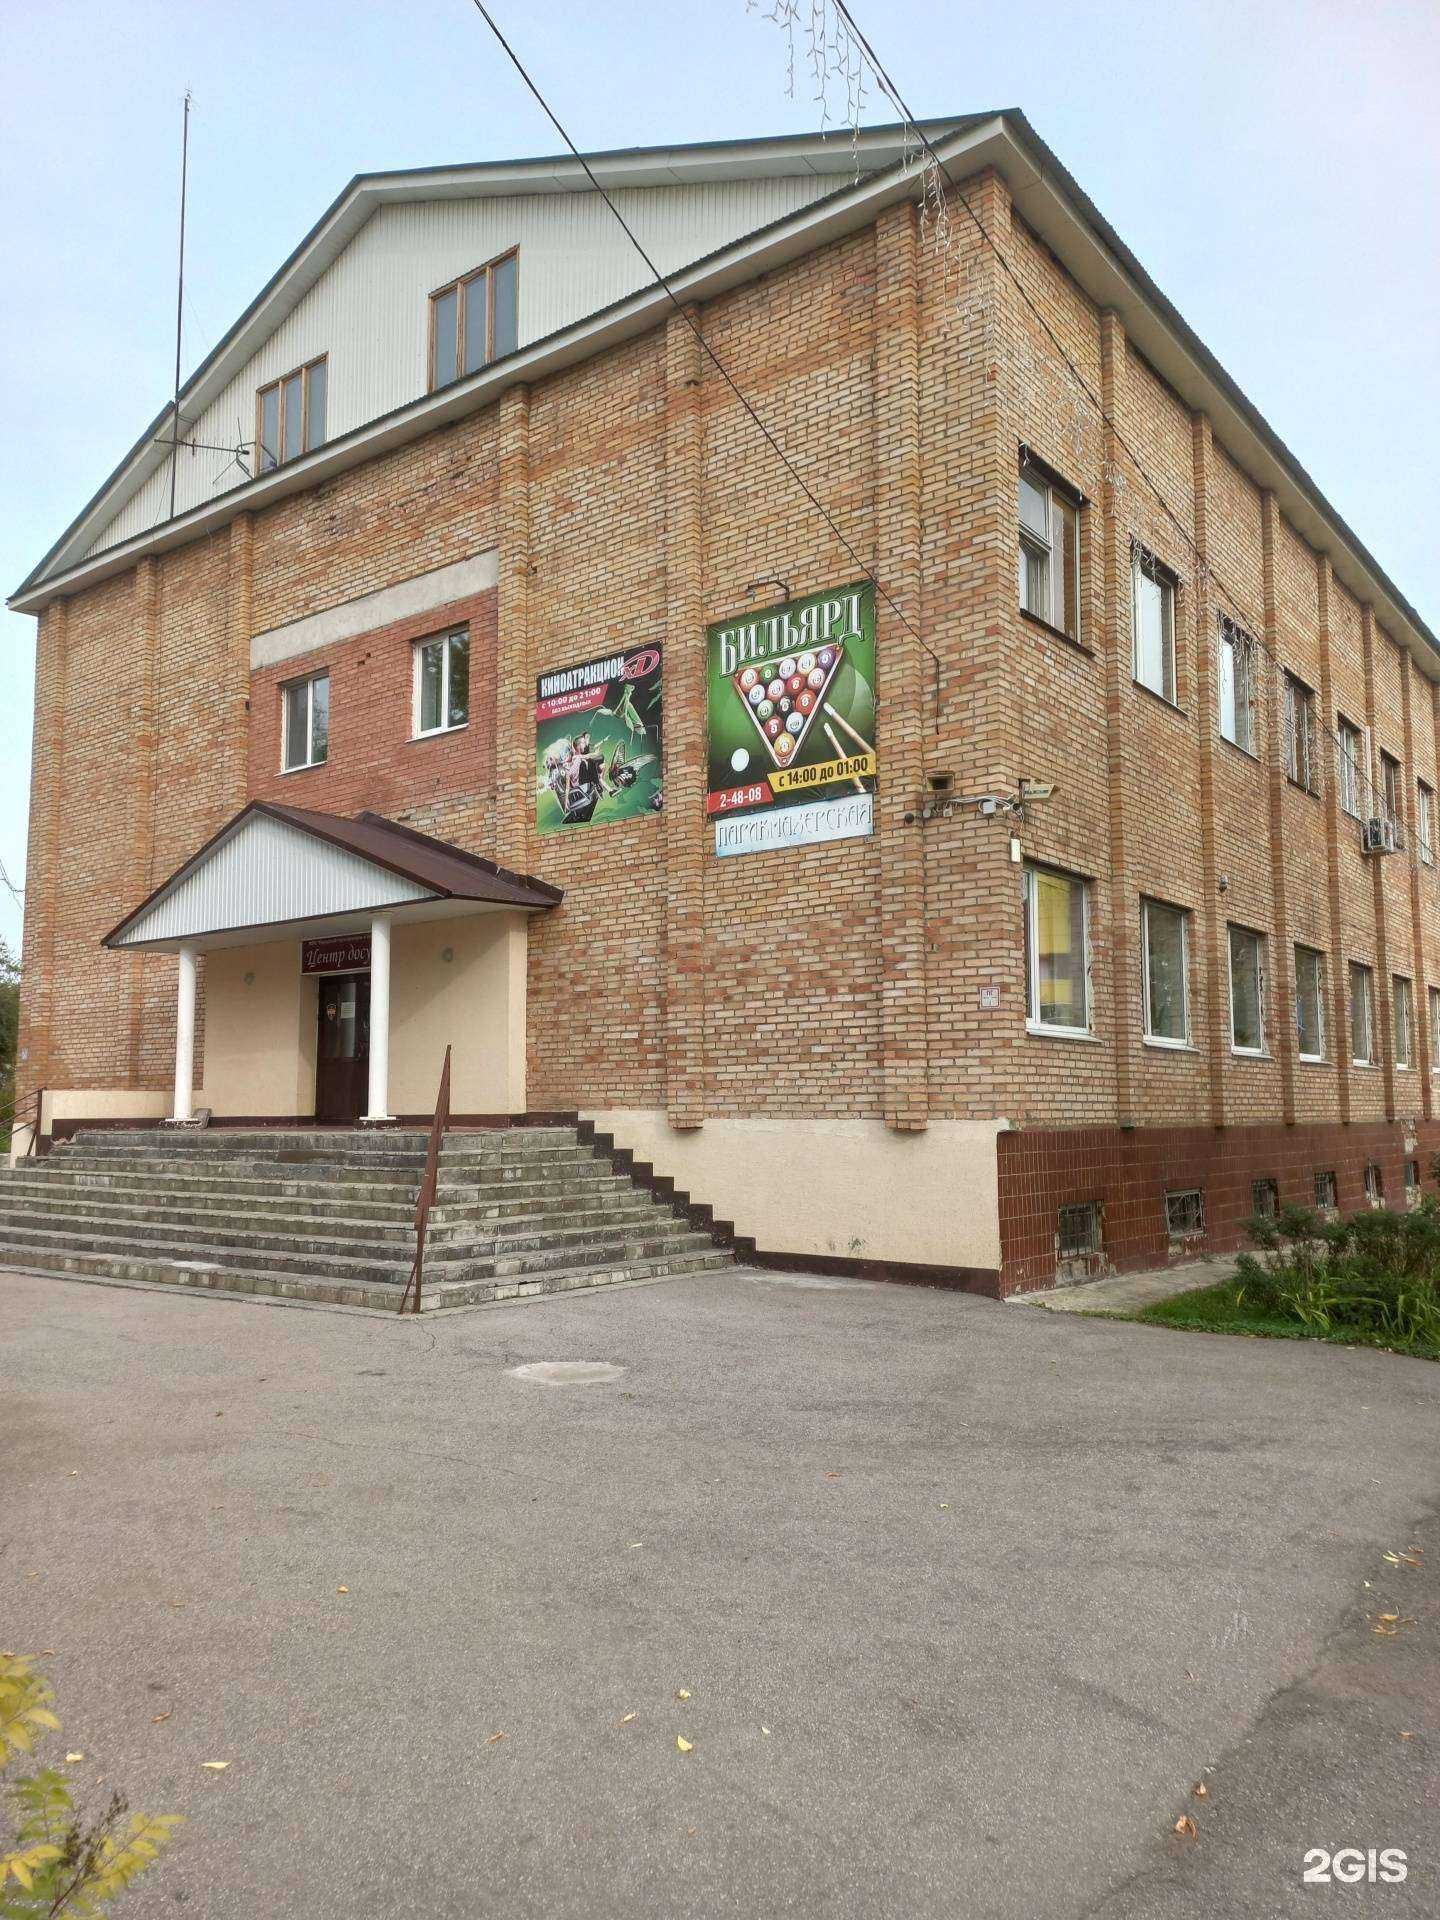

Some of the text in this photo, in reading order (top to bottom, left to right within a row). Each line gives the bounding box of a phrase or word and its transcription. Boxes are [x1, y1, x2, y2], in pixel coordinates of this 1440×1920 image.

[719, 592, 865, 678] БИЛЬЯРД
[547, 696, 568, 708] 10:00
[568, 694, 578, 704] до
[579, 687, 601, 699] 21:00
[787, 767, 817, 784] 14:00
[819, 765, 834, 783] до
[836, 757, 869, 776] 01:00
[719, 786, 762, 808] 2-48-08
[718, 802, 873, 848] ПАРИКМАХЕРСКАЯ
[304, 943, 371, 968] Центр досу
